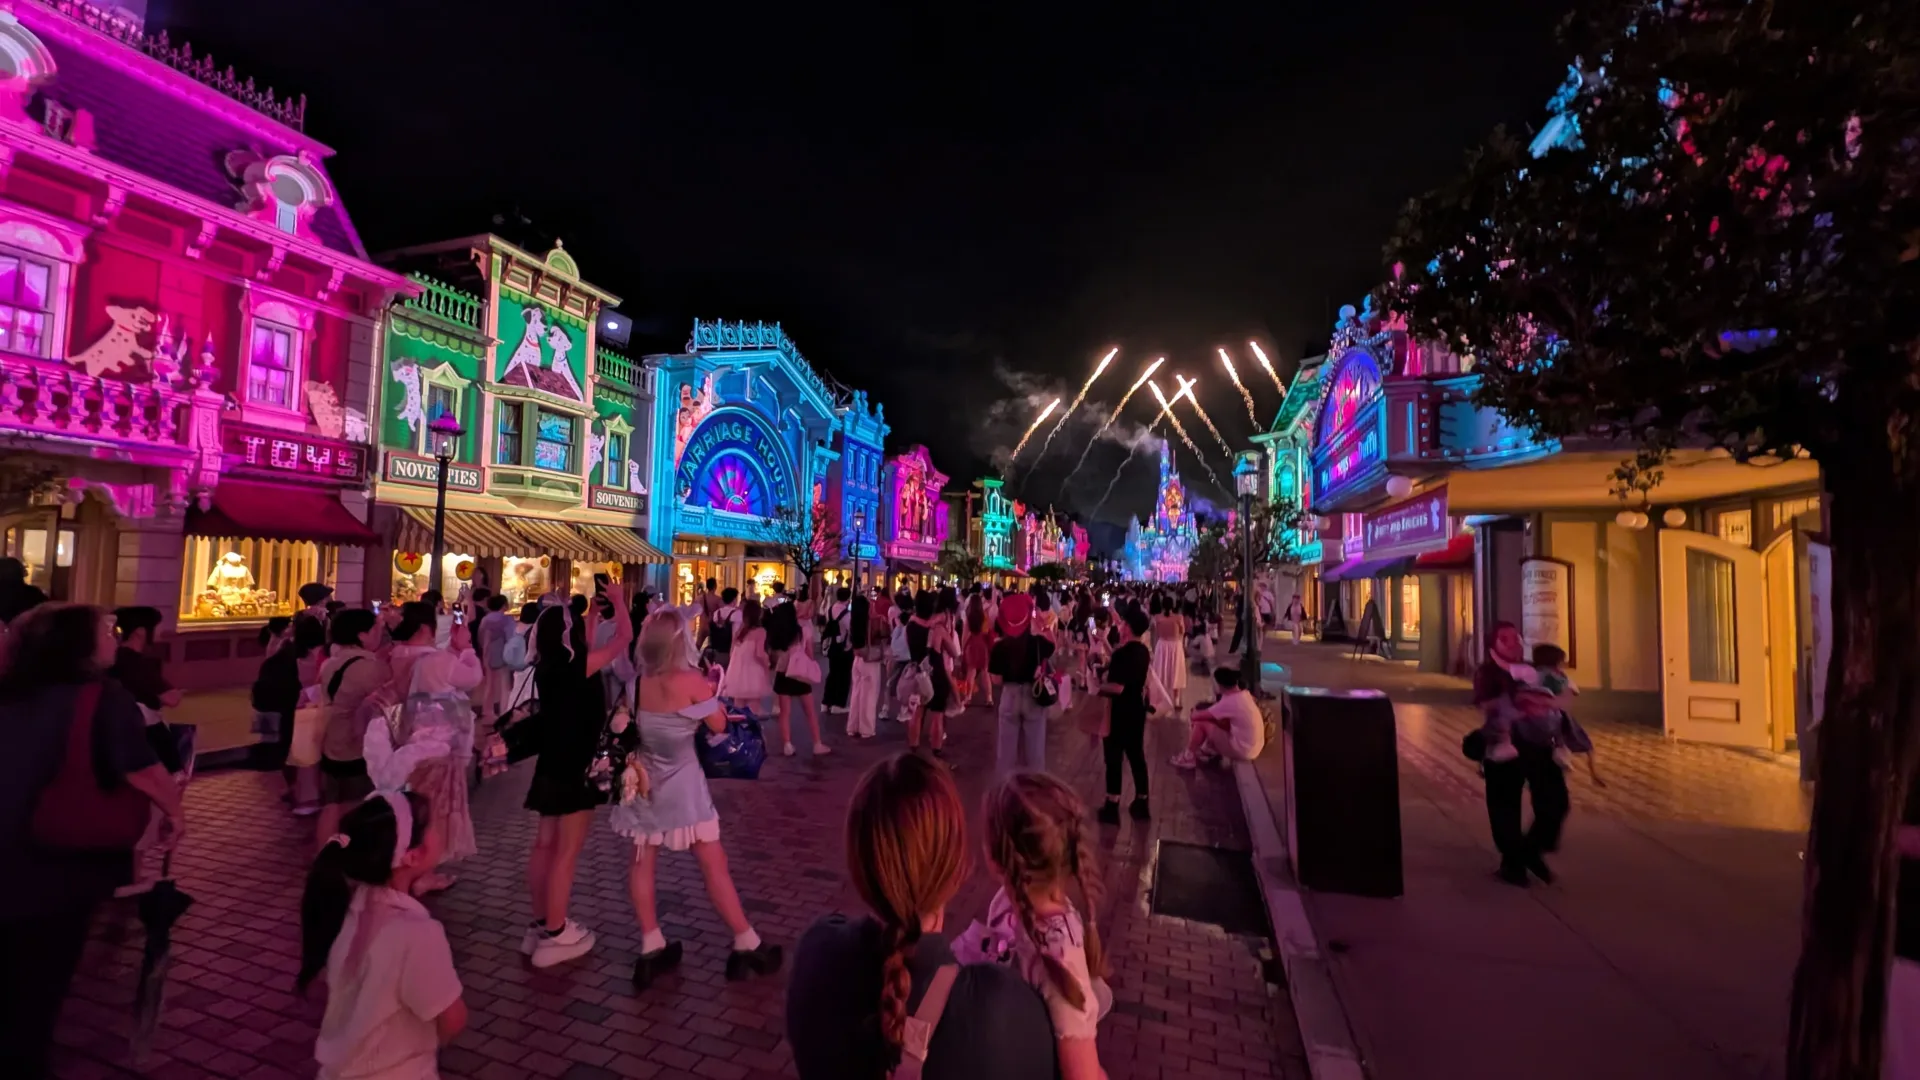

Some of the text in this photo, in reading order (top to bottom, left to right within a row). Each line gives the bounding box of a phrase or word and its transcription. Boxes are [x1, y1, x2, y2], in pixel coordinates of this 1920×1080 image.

[240, 435, 357, 477] TOYS
[394, 459, 477, 486] NOVETIES
[596, 491, 644, 509] SOUVENIRS
